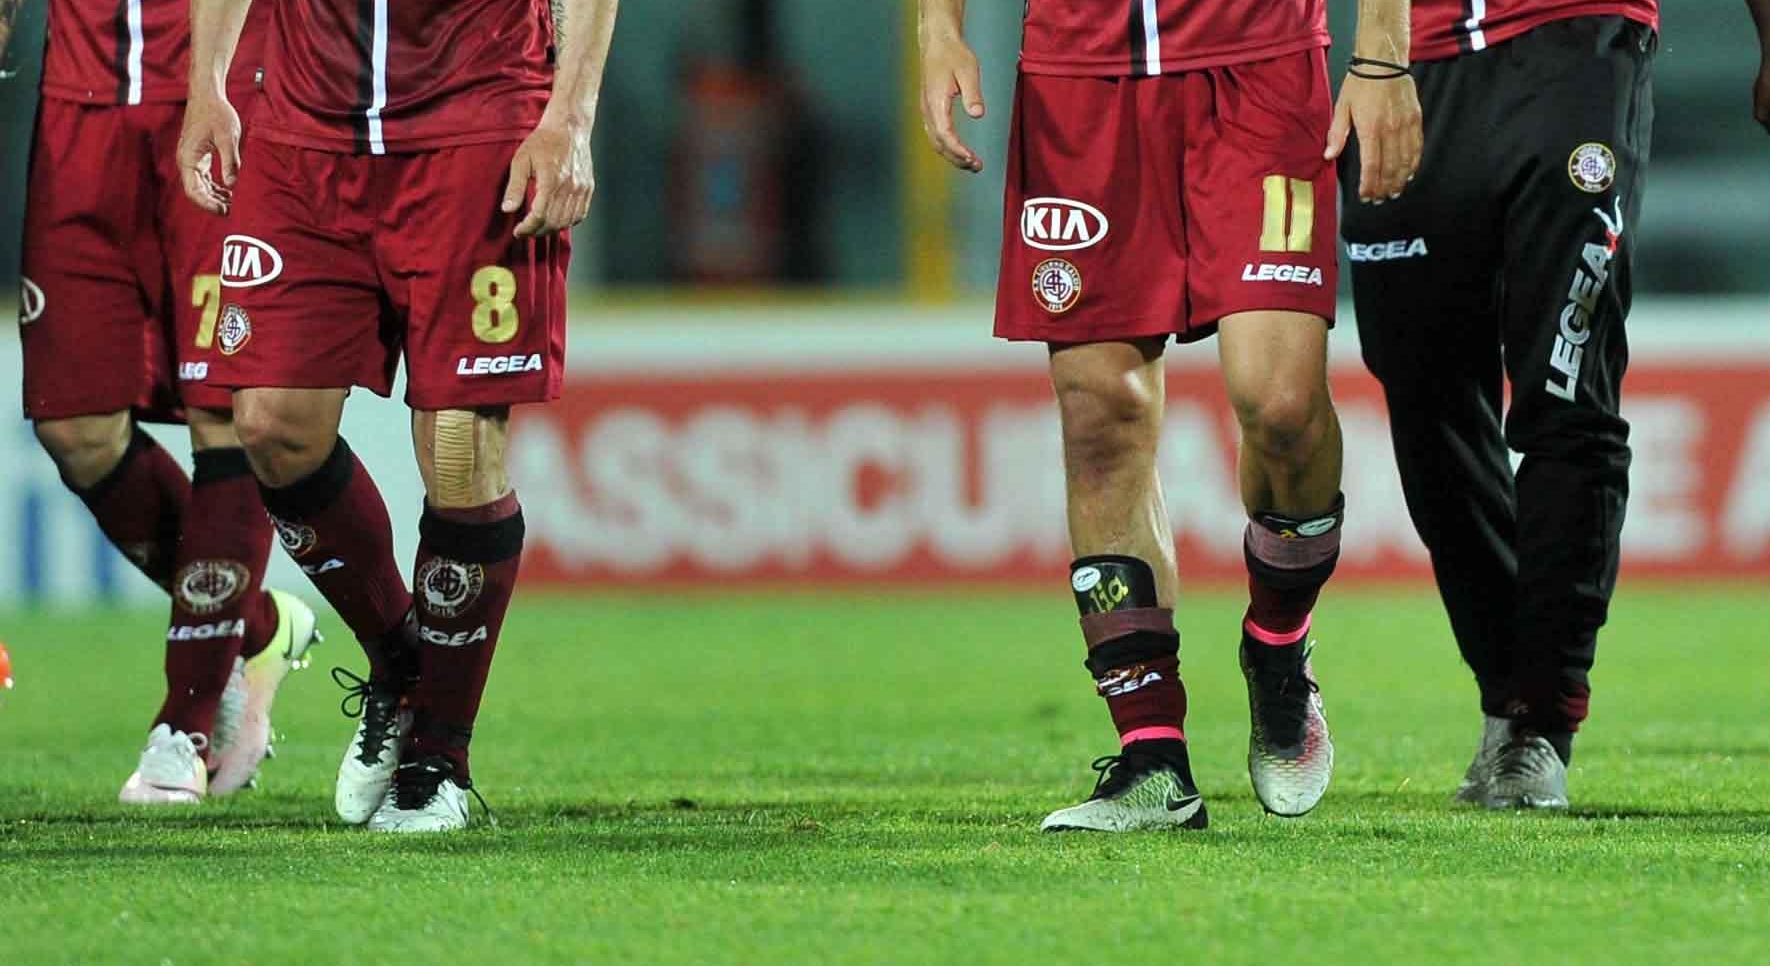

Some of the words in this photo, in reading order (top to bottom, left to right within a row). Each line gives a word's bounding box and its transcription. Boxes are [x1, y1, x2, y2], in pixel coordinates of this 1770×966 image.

[1025, 206, 1091, 241] KIA
[1259, 175, 1315, 252] 11
[221, 245, 263, 279] KIA
[1241, 263, 1323, 286] LEGEA
[191, 273, 221, 349] 7
[470, 265, 519, 344] 8
[1545, 241, 1610, 403] LEGEA
[178, 361, 209, 380] LEG
[456, 353, 543, 375] LEGEA
